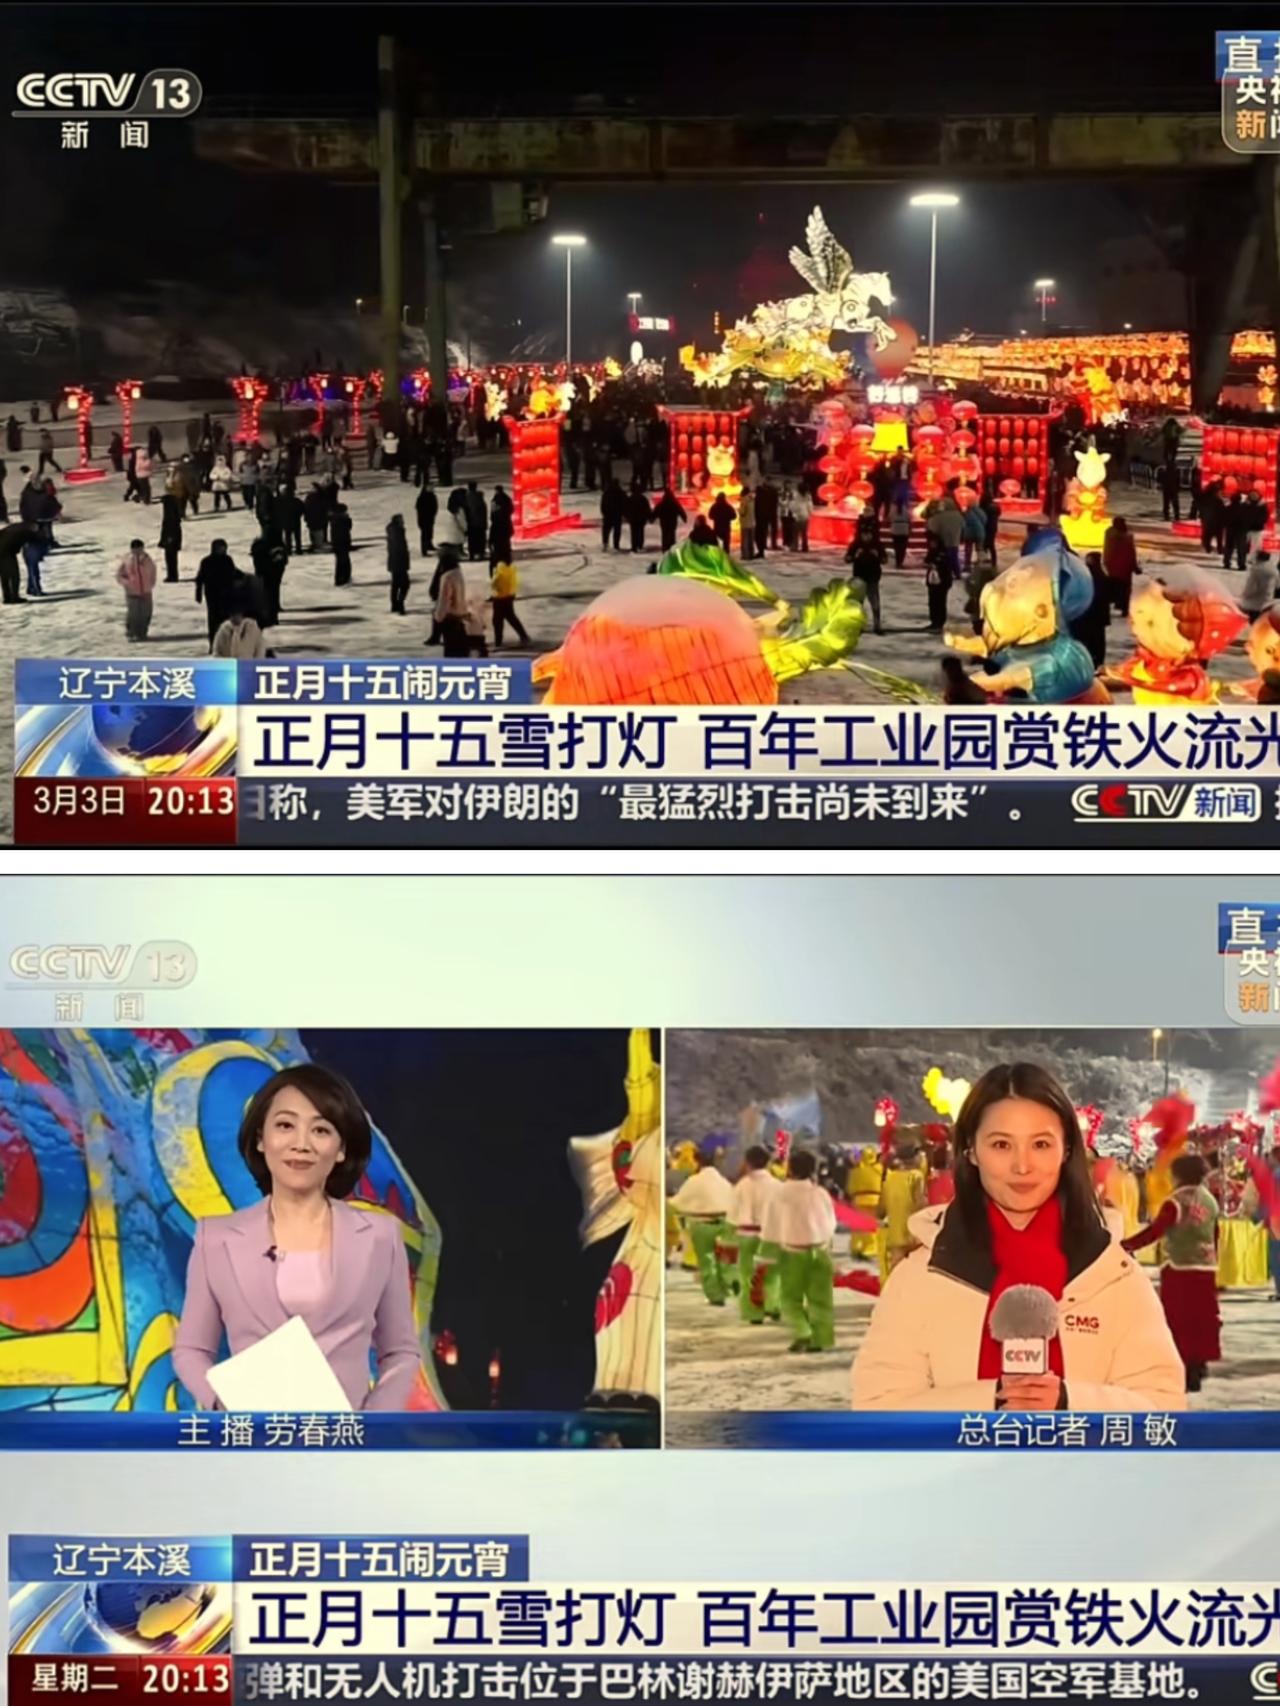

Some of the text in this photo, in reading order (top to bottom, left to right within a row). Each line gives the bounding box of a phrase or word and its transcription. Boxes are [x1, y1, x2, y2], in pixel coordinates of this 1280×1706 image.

[1224, 35, 1280, 73] 直
[16, 73, 191, 109] CCTV 13
[61, 121, 149, 149] 新闻
[59, 667, 195, 698] 辽宁本溪
[254, 666, 511, 701] 正月十五闹元宵
[253, 711, 1280, 770] 正月十五雪打灯 百年工业园赏铁火流光
[34, 785, 234, 815] 3月3日 20:13
[1071, 784, 1186, 817] CCTV
[1194, 786, 1257, 818] 新闻
[1227, 906, 1280, 944] 直
[9, 944, 187, 983] CCTV 13
[1239, 946, 1280, 977] 央
[1239, 982, 1280, 1012] 新
[1064, 1314, 1099, 1328] CMG
[1005, 1349, 1041, 1363] CCTV
[265, 1413, 365, 1447] 劳春燕
[957, 1413, 1090, 1446] 总台记者
[53, 1543, 191, 1576] 辽宁本溪
[249, 1542, 510, 1578] 正月十五闹元宵
[249, 1587, 1280, 1648] 正月十五雪打灯 百年工业园赏铁火流光
[32, 1664, 229, 1694] 星期二 20:13
